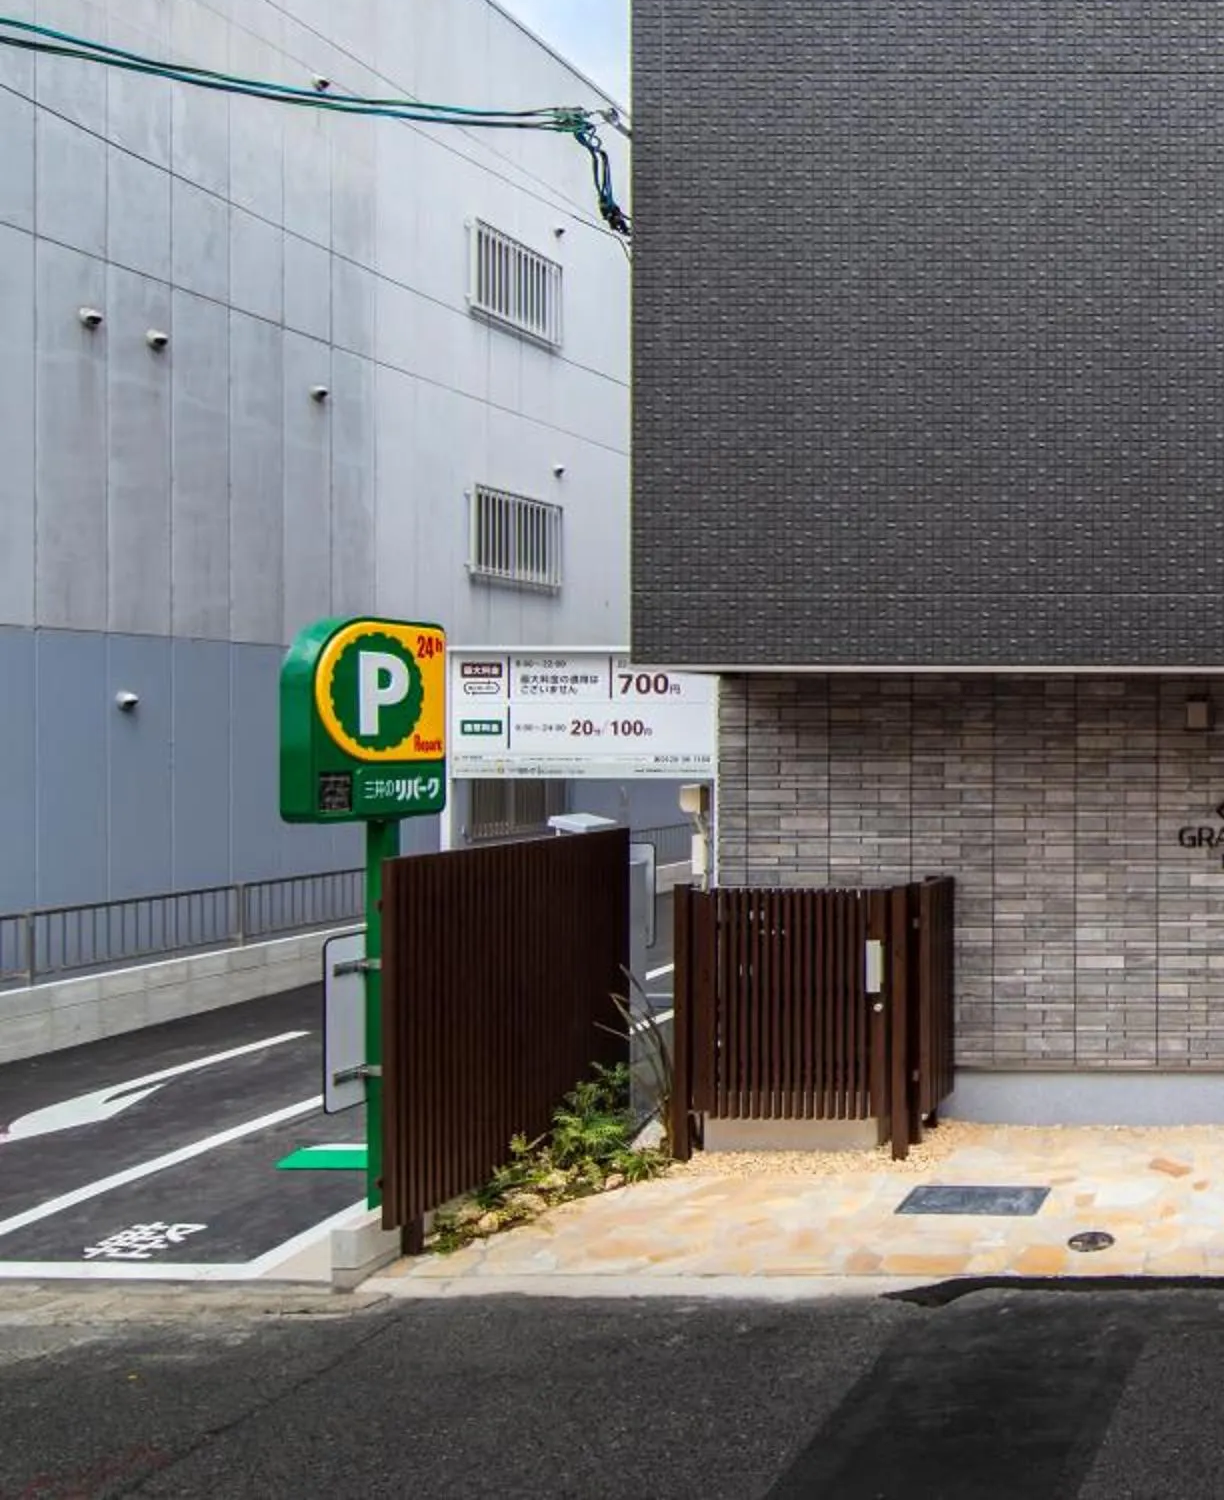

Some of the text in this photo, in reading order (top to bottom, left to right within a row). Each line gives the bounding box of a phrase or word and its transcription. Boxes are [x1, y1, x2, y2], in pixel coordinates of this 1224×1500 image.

[359, 651, 410, 735] P
[618, 673, 681, 695] 700円
[363, 776, 439, 801] 三井のリパーク
